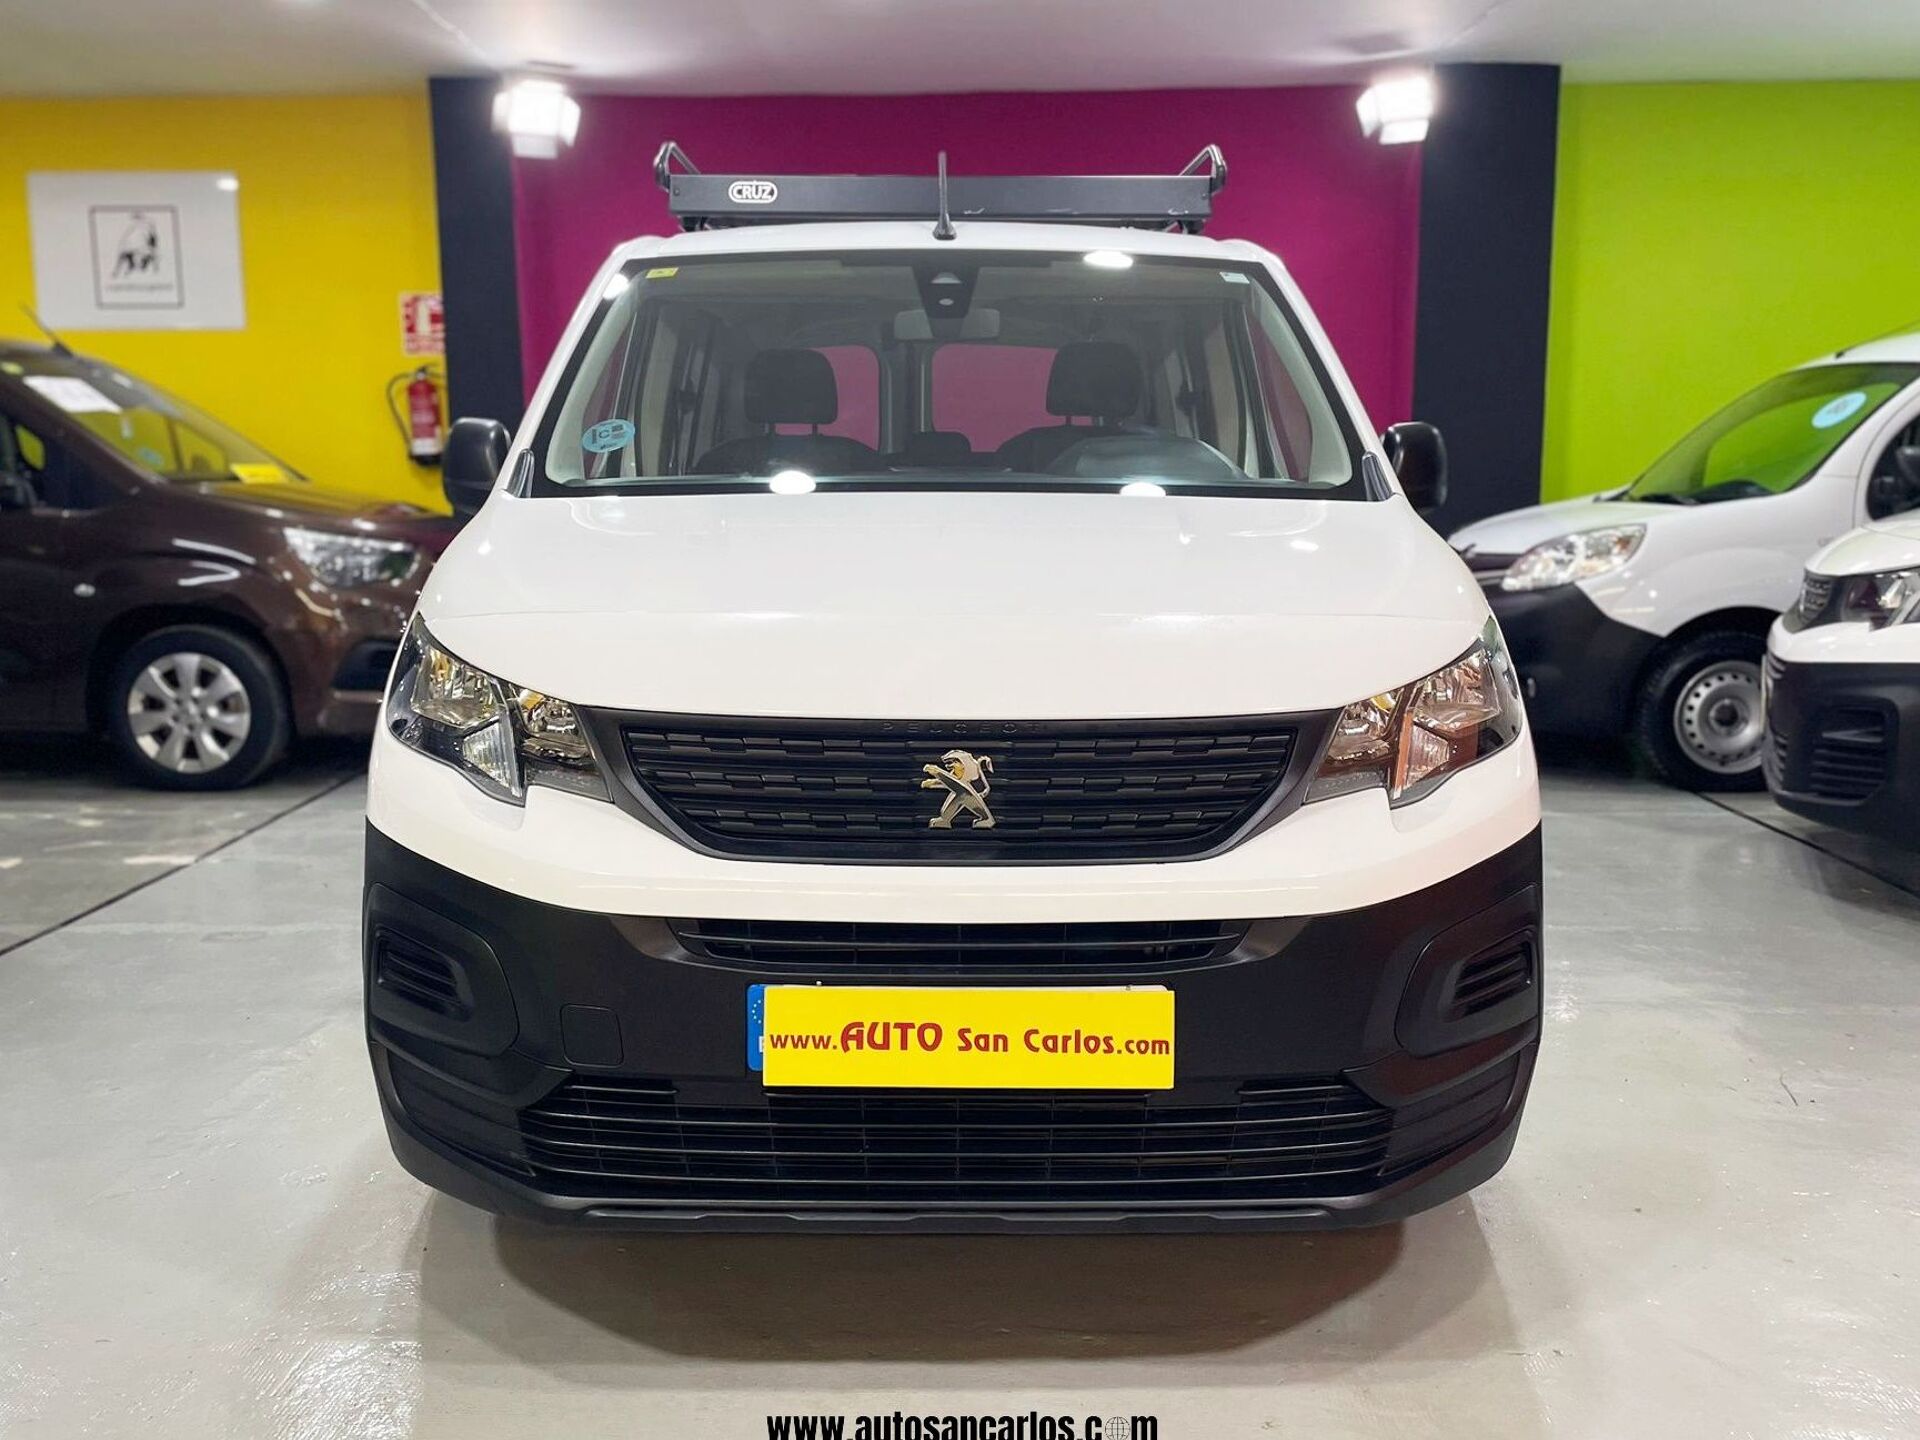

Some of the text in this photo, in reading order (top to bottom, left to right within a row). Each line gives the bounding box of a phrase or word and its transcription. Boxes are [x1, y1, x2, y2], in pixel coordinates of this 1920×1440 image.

[732, 184, 773, 200] CRUZ
[881, 721, 1042, 735] PEUGEOT
[769, 1021, 943, 1053] www.AUTO
[957, 1027, 1009, 1053] San
[1023, 1028, 1170, 1055] Carlos.com
